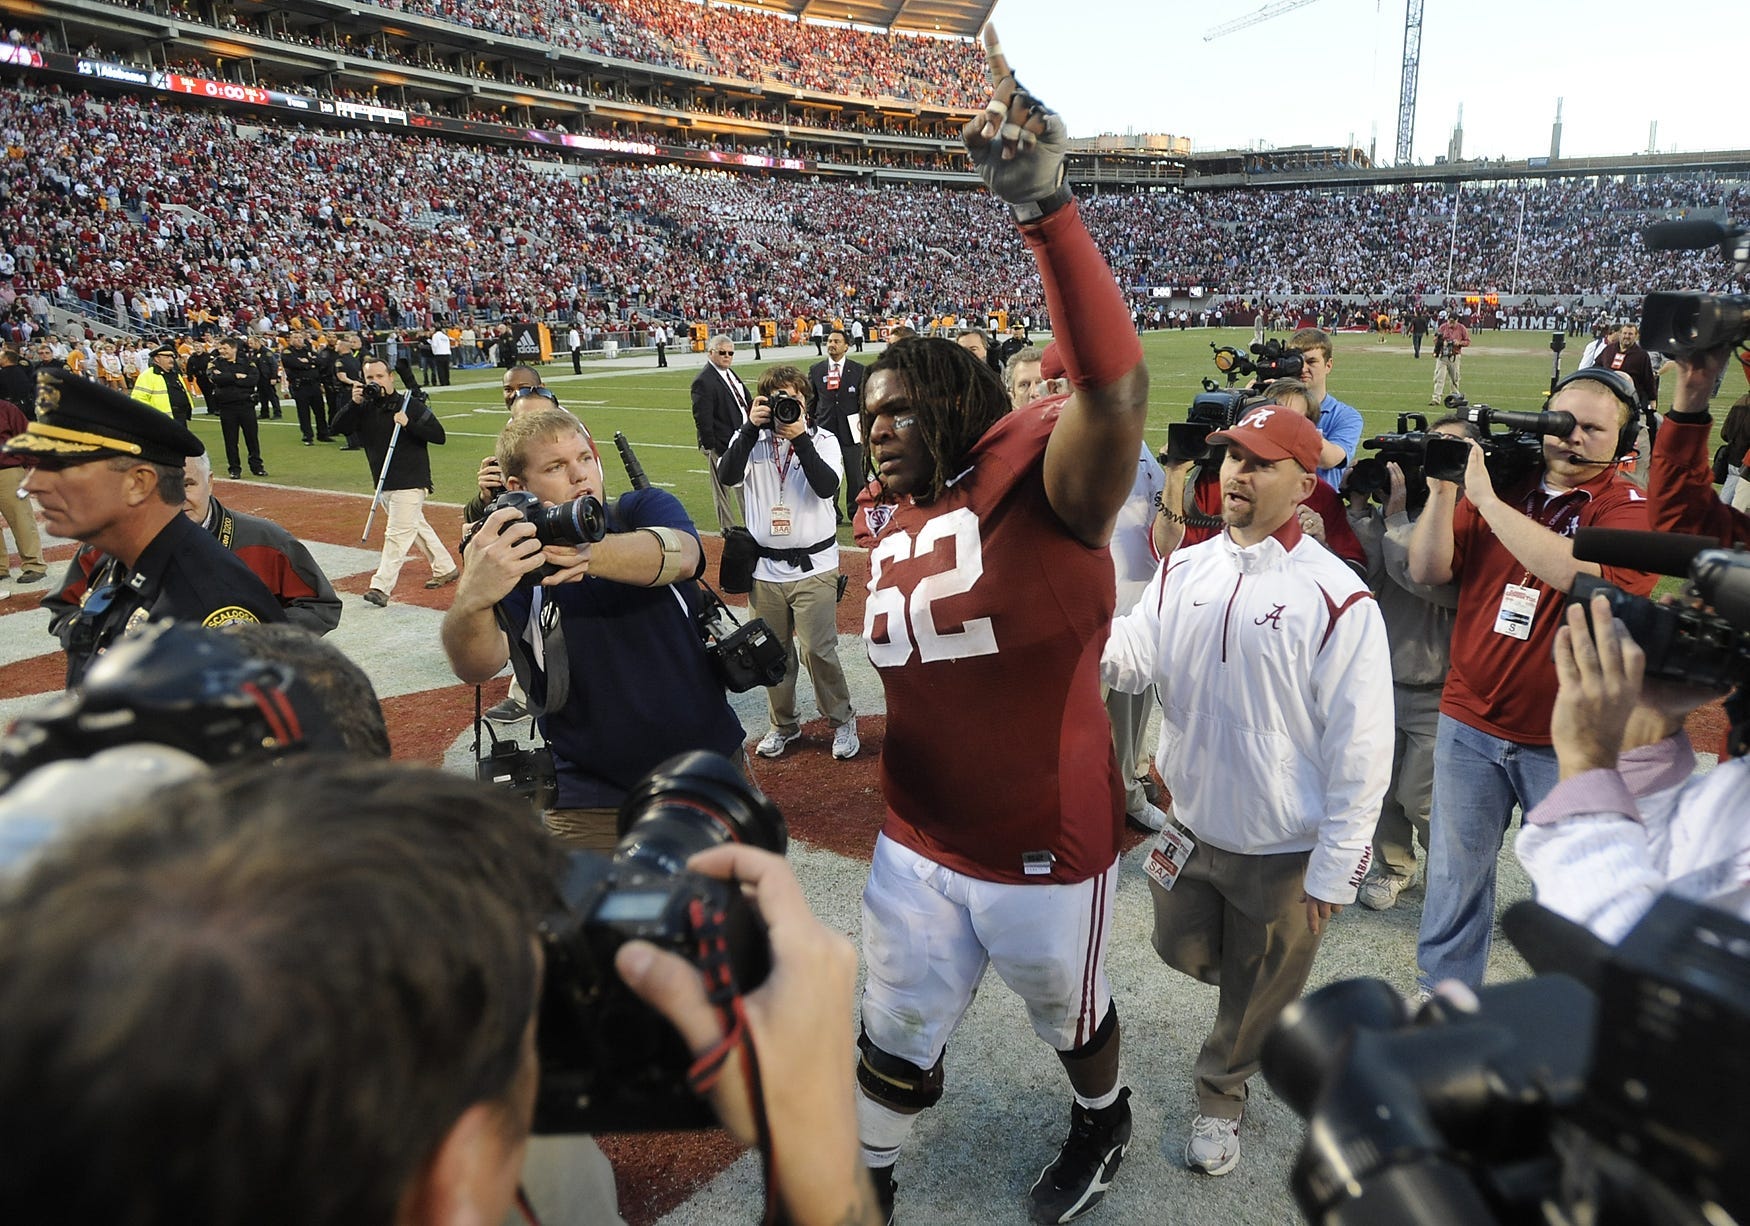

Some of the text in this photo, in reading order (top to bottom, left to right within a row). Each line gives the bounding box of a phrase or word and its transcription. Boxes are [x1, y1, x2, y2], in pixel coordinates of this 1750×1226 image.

[78, 60, 147, 83] 12 Alabama
[205, 82, 245, 100] 0:00
[1238, 408, 1275, 429] A
[223, 517, 232, 535] D200
[863, 507, 999, 667] 62
[207, 609, 255, 629] SCALOOSA
[1254, 603, 1286, 630] A
[1508, 623, 1517, 632] S
[1349, 845, 1372, 889] ALABAMA
